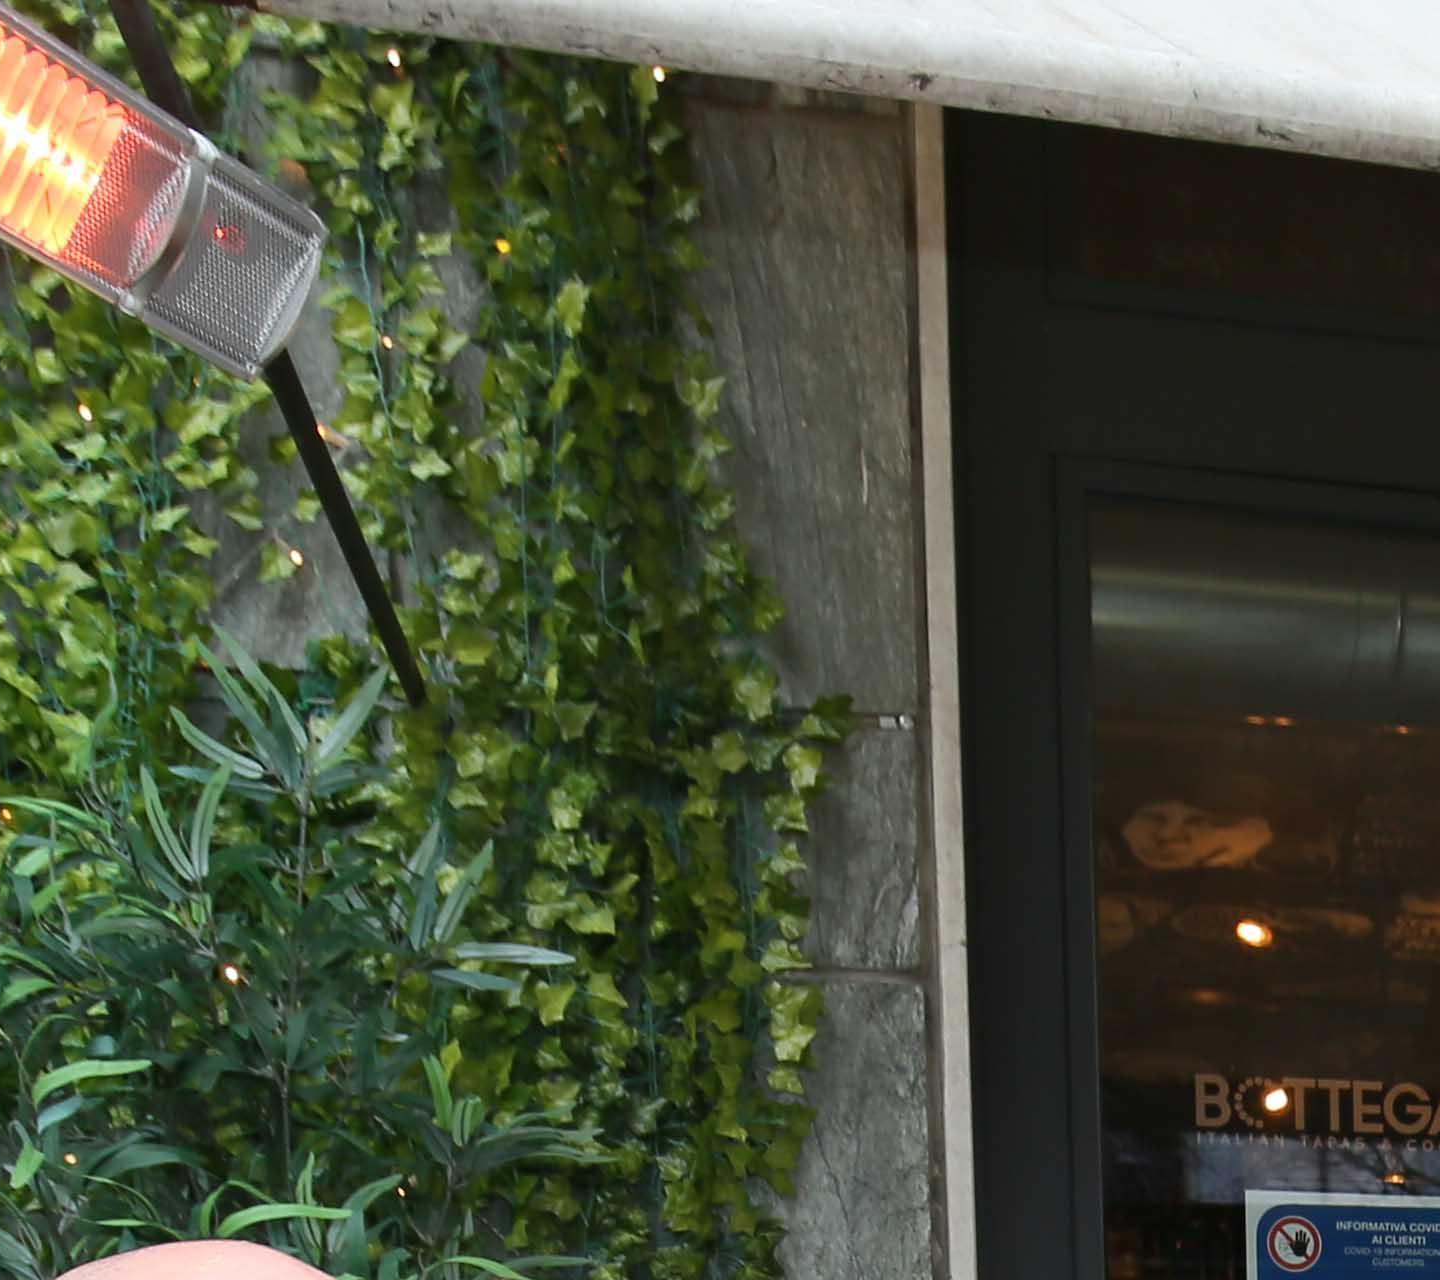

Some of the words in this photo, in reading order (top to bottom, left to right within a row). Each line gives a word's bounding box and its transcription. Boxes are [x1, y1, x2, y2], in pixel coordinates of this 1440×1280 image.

[1197, 1133, 1285, 1148] ITALIAN
[1301, 1135, 1365, 1150] TAPAS
[1336, 1220, 1407, 1232] INFORMATIVA
[1372, 1235, 1382, 1245] AI
[1384, 1235, 1426, 1246] CLIENTI
